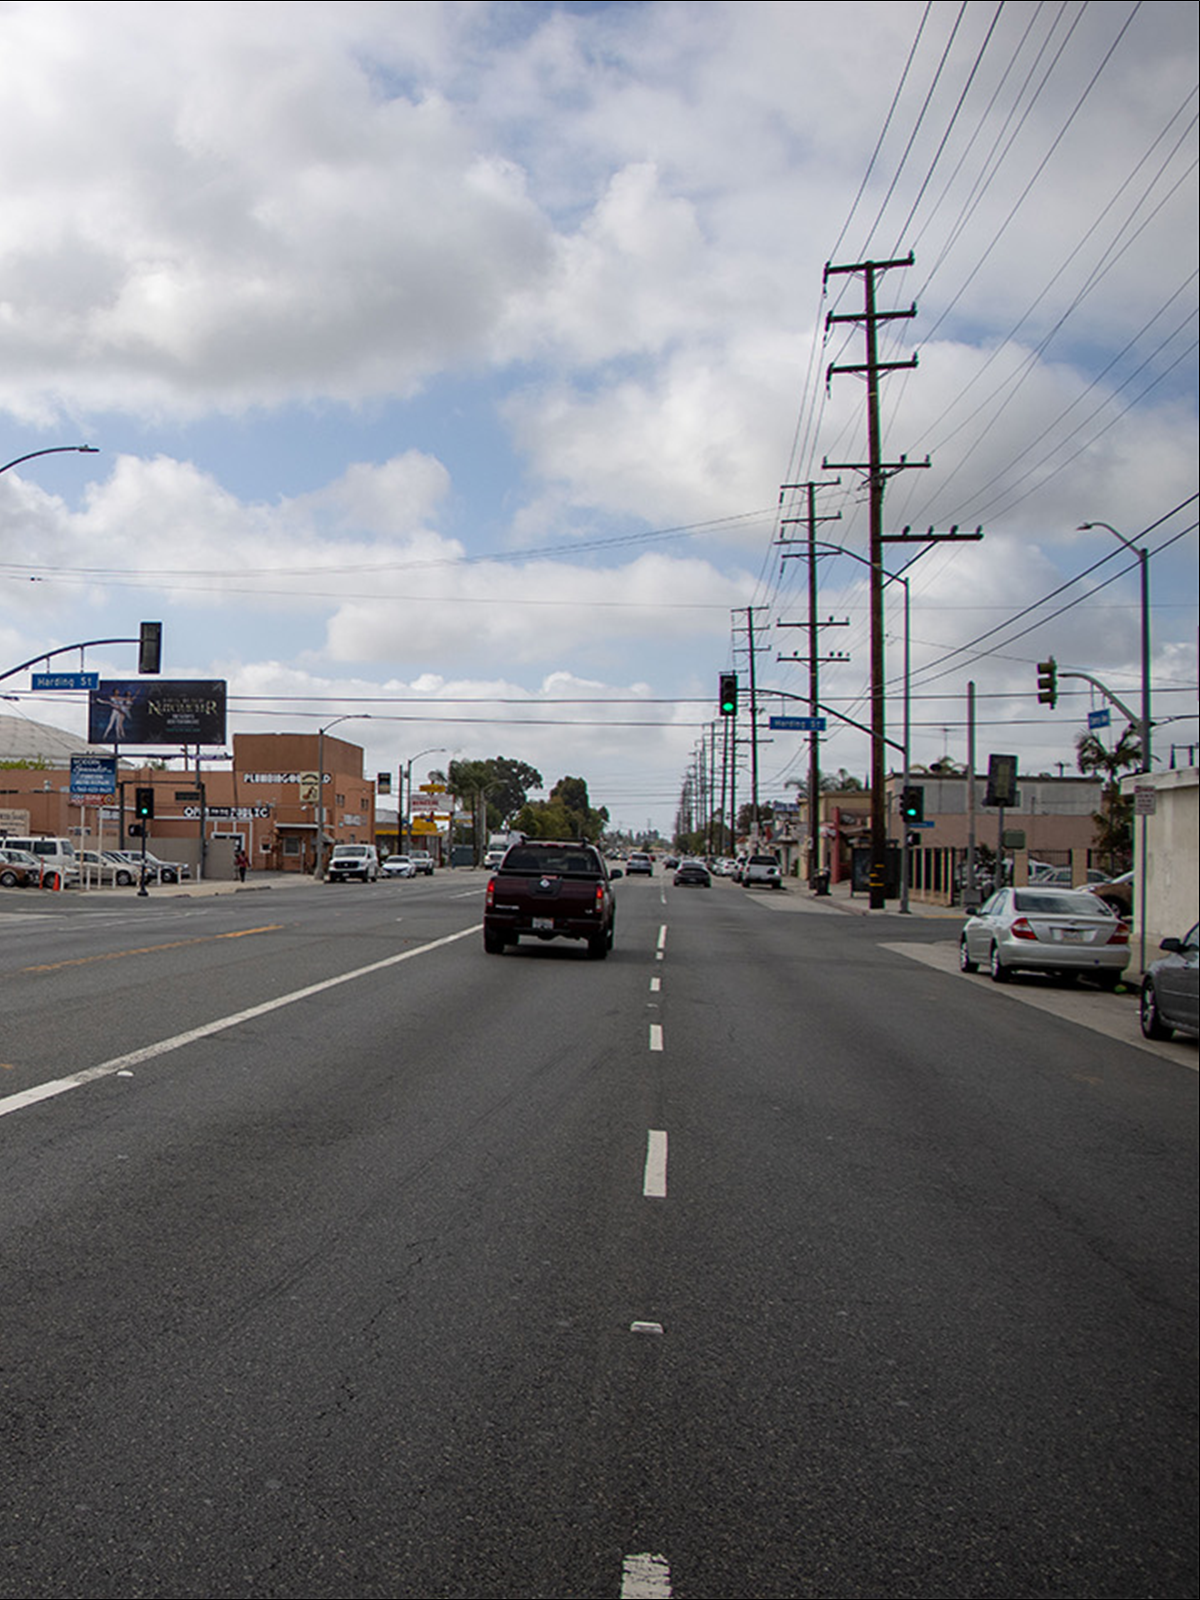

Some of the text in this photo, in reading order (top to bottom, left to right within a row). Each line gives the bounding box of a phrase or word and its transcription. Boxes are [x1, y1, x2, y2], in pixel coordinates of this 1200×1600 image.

[37, 676, 92, 688] Harding St
[230, 806, 270, 819] PUBLIC
